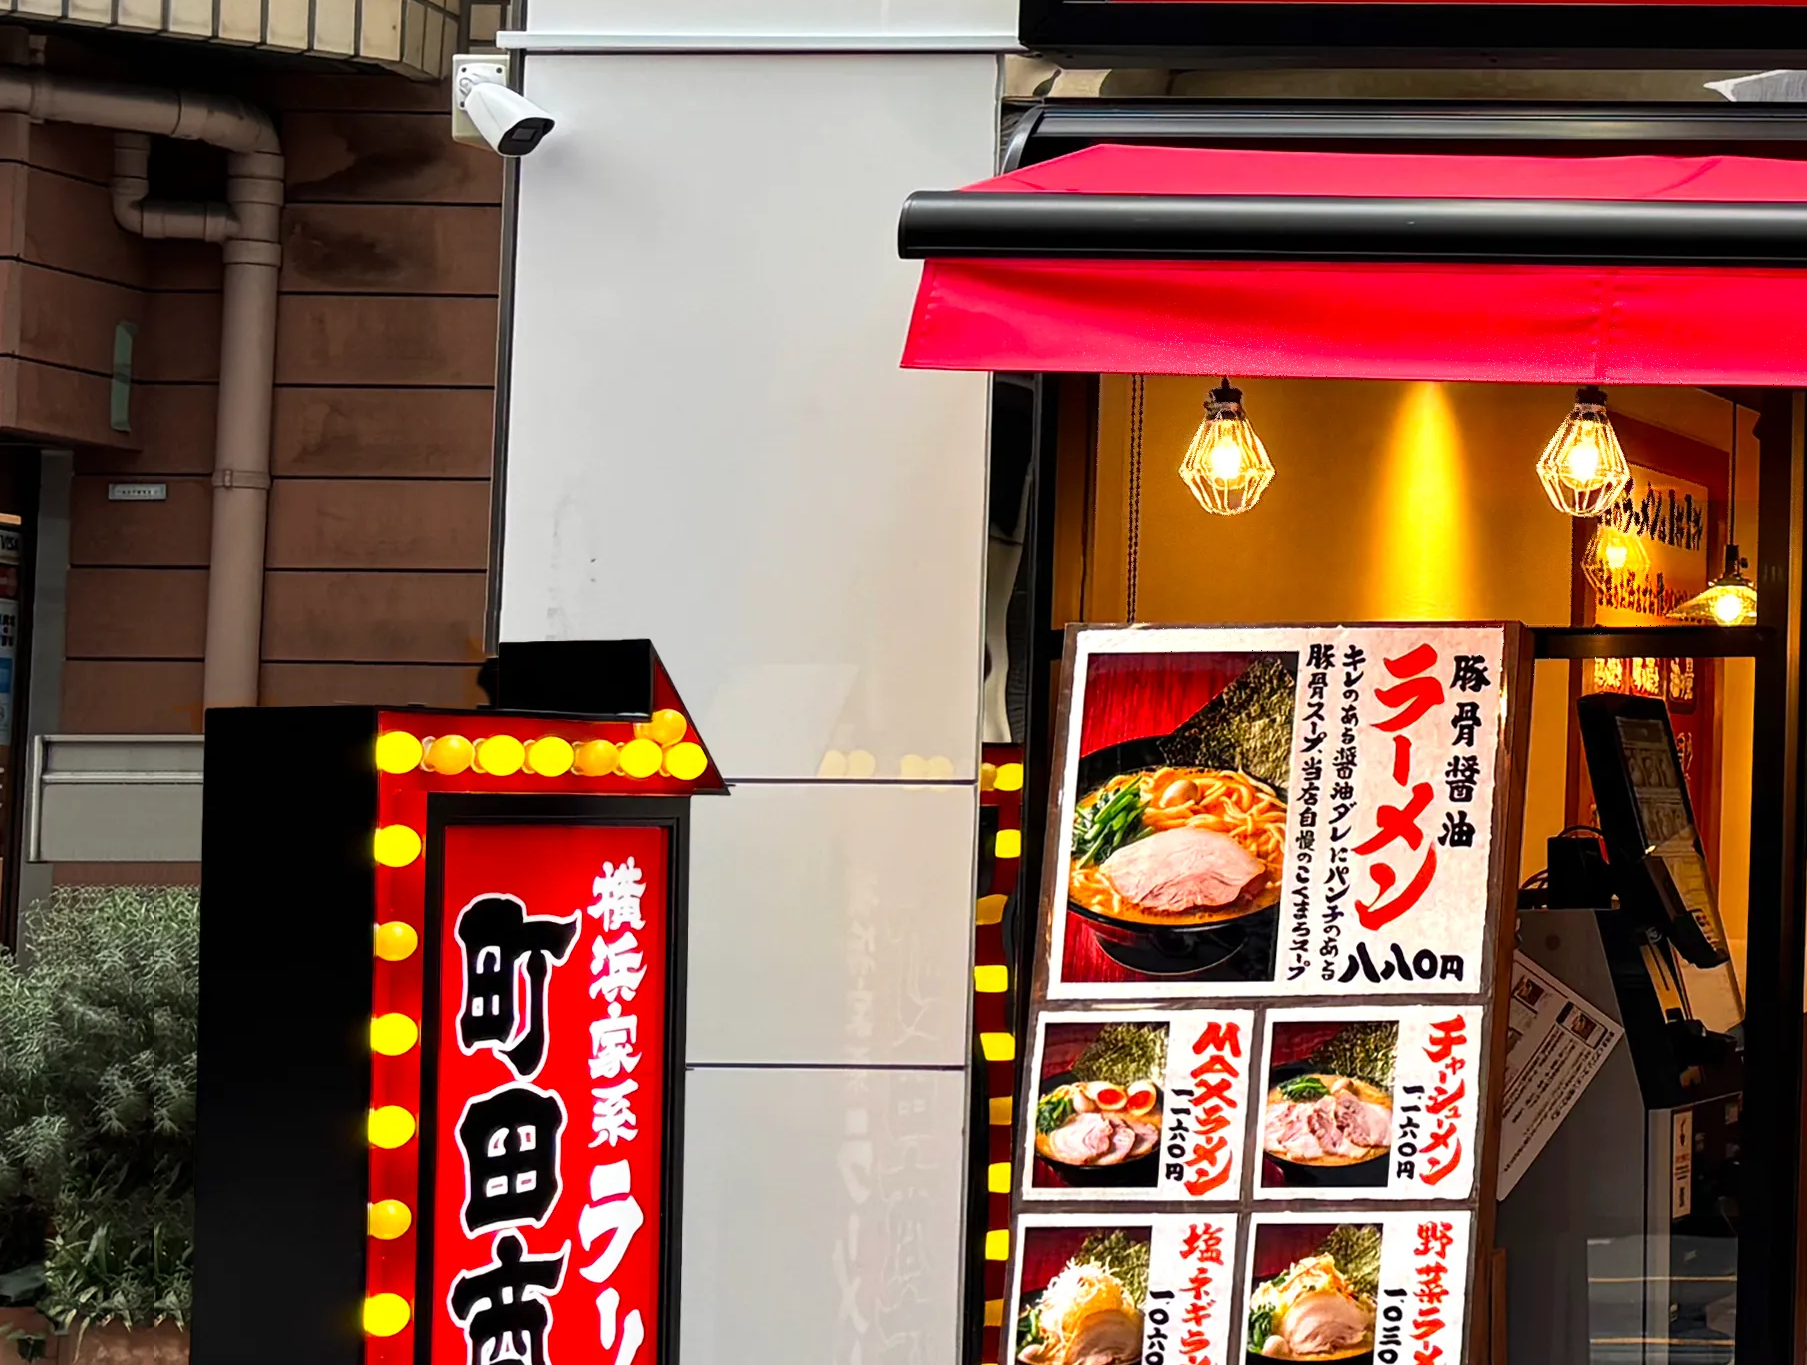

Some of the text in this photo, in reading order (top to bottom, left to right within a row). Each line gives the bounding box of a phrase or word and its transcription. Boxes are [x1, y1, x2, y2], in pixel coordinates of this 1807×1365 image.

[1351, 643, 1445, 931] ラーメン
[1436, 654, 1492, 849] 豚骨醤油
[1183, 1021, 1242, 1197] MAXラーメン
[1418, 1014, 1467, 1187] チャーシューメン
